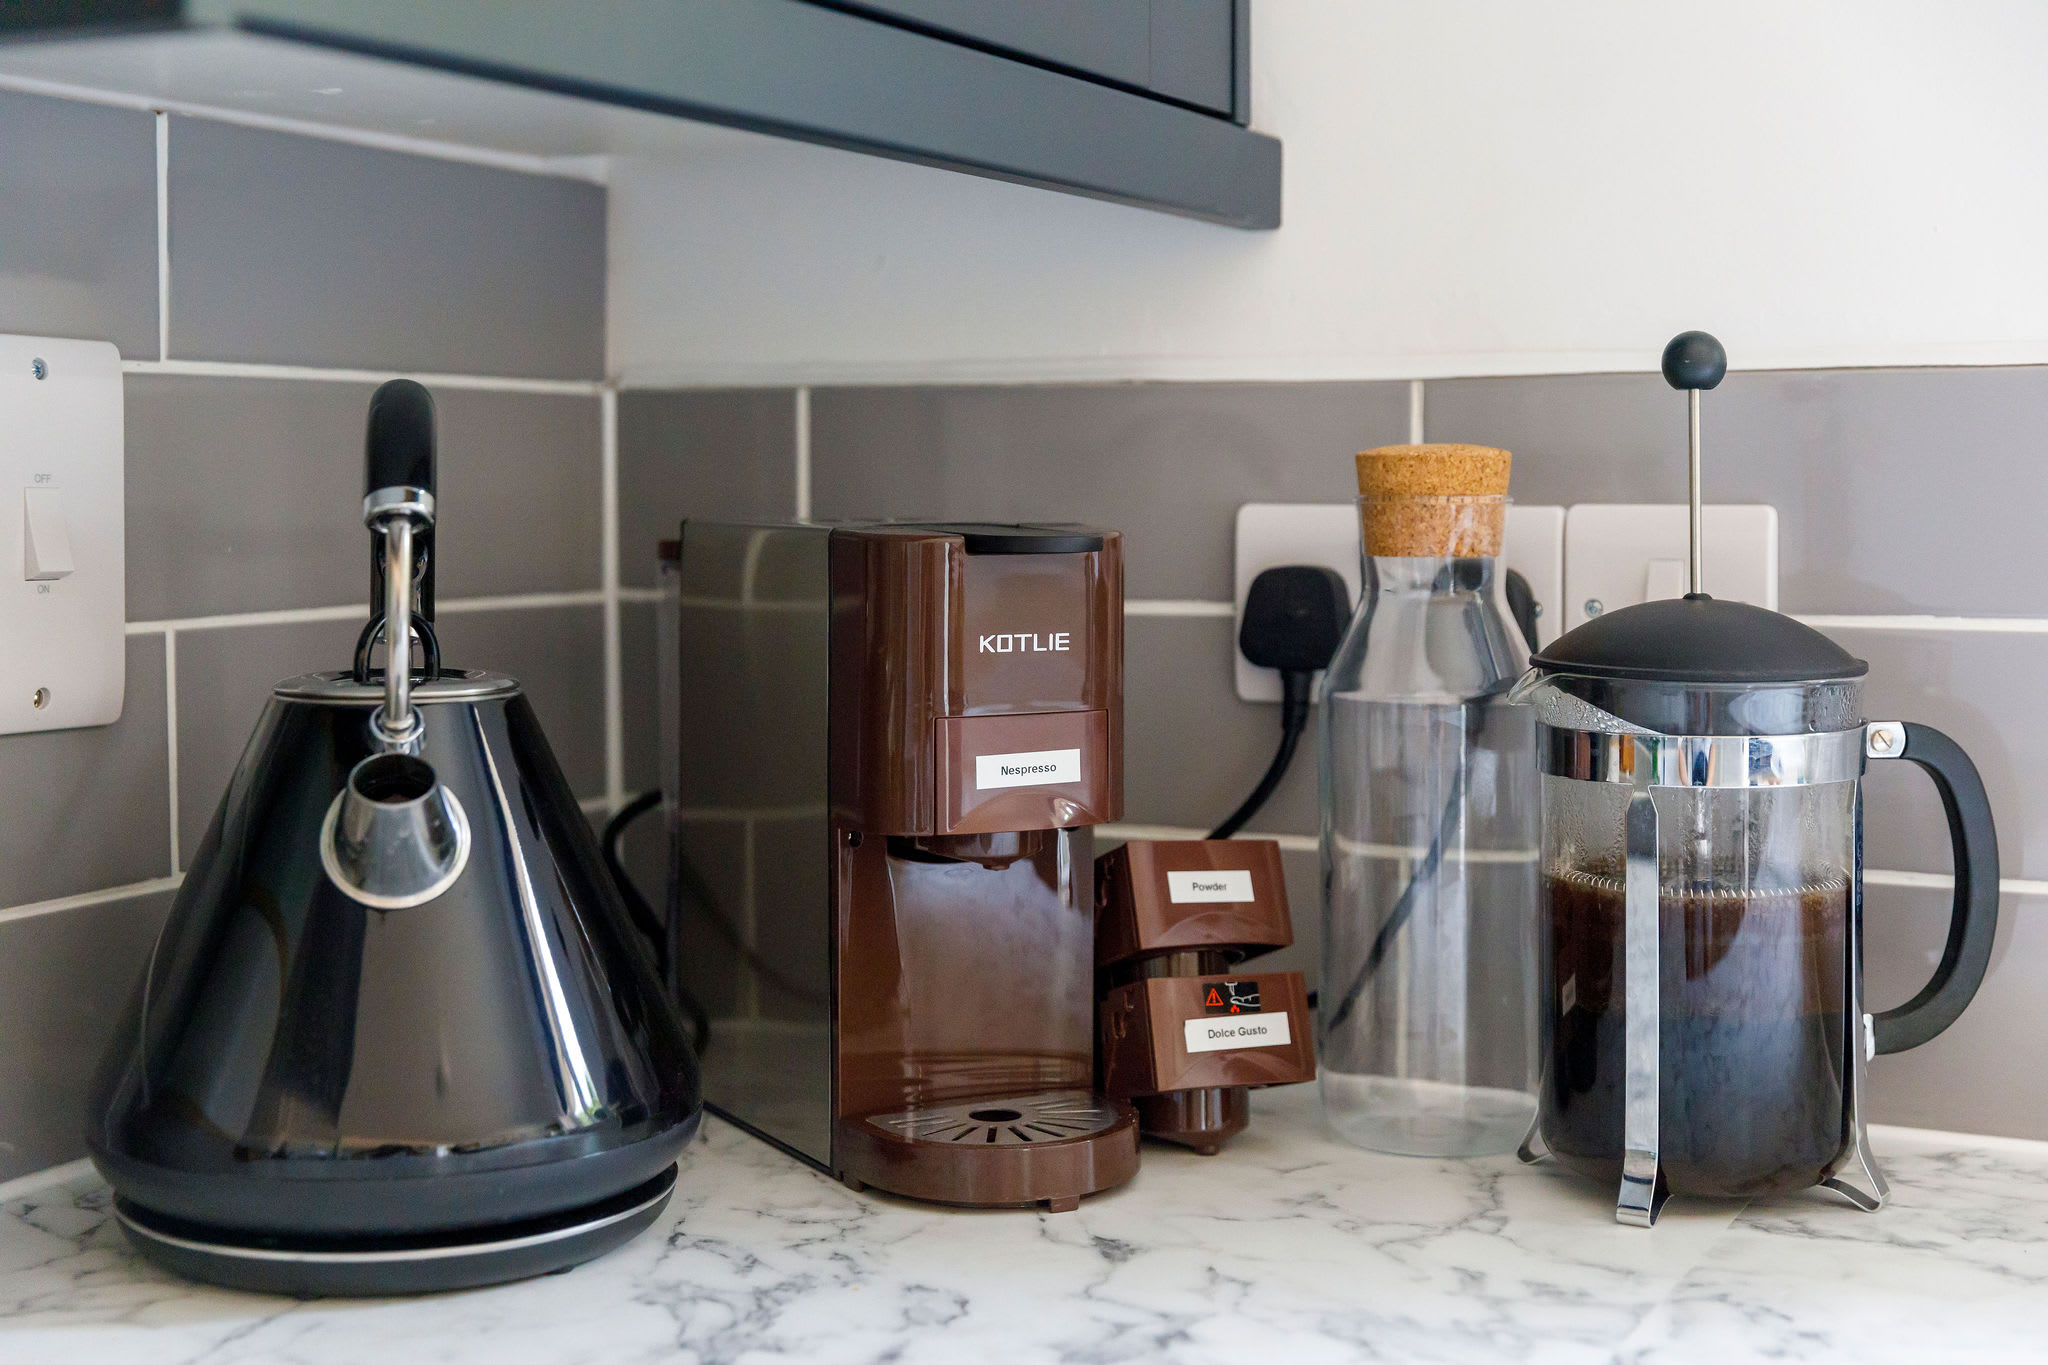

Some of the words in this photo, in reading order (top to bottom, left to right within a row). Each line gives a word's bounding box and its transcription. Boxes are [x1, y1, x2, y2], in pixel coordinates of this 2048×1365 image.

[33, 473, 52, 483] OFF
[37, 585, 50, 594] ON
[979, 632, 1070, 654] KOTLIE
[1000, 764, 1057, 777] Nespresso
[1192, 882, 1227, 892] Powder
[1208, 1028, 1236, 1039] Dolce
[1238, 1026, 1268, 1036] Gusto
